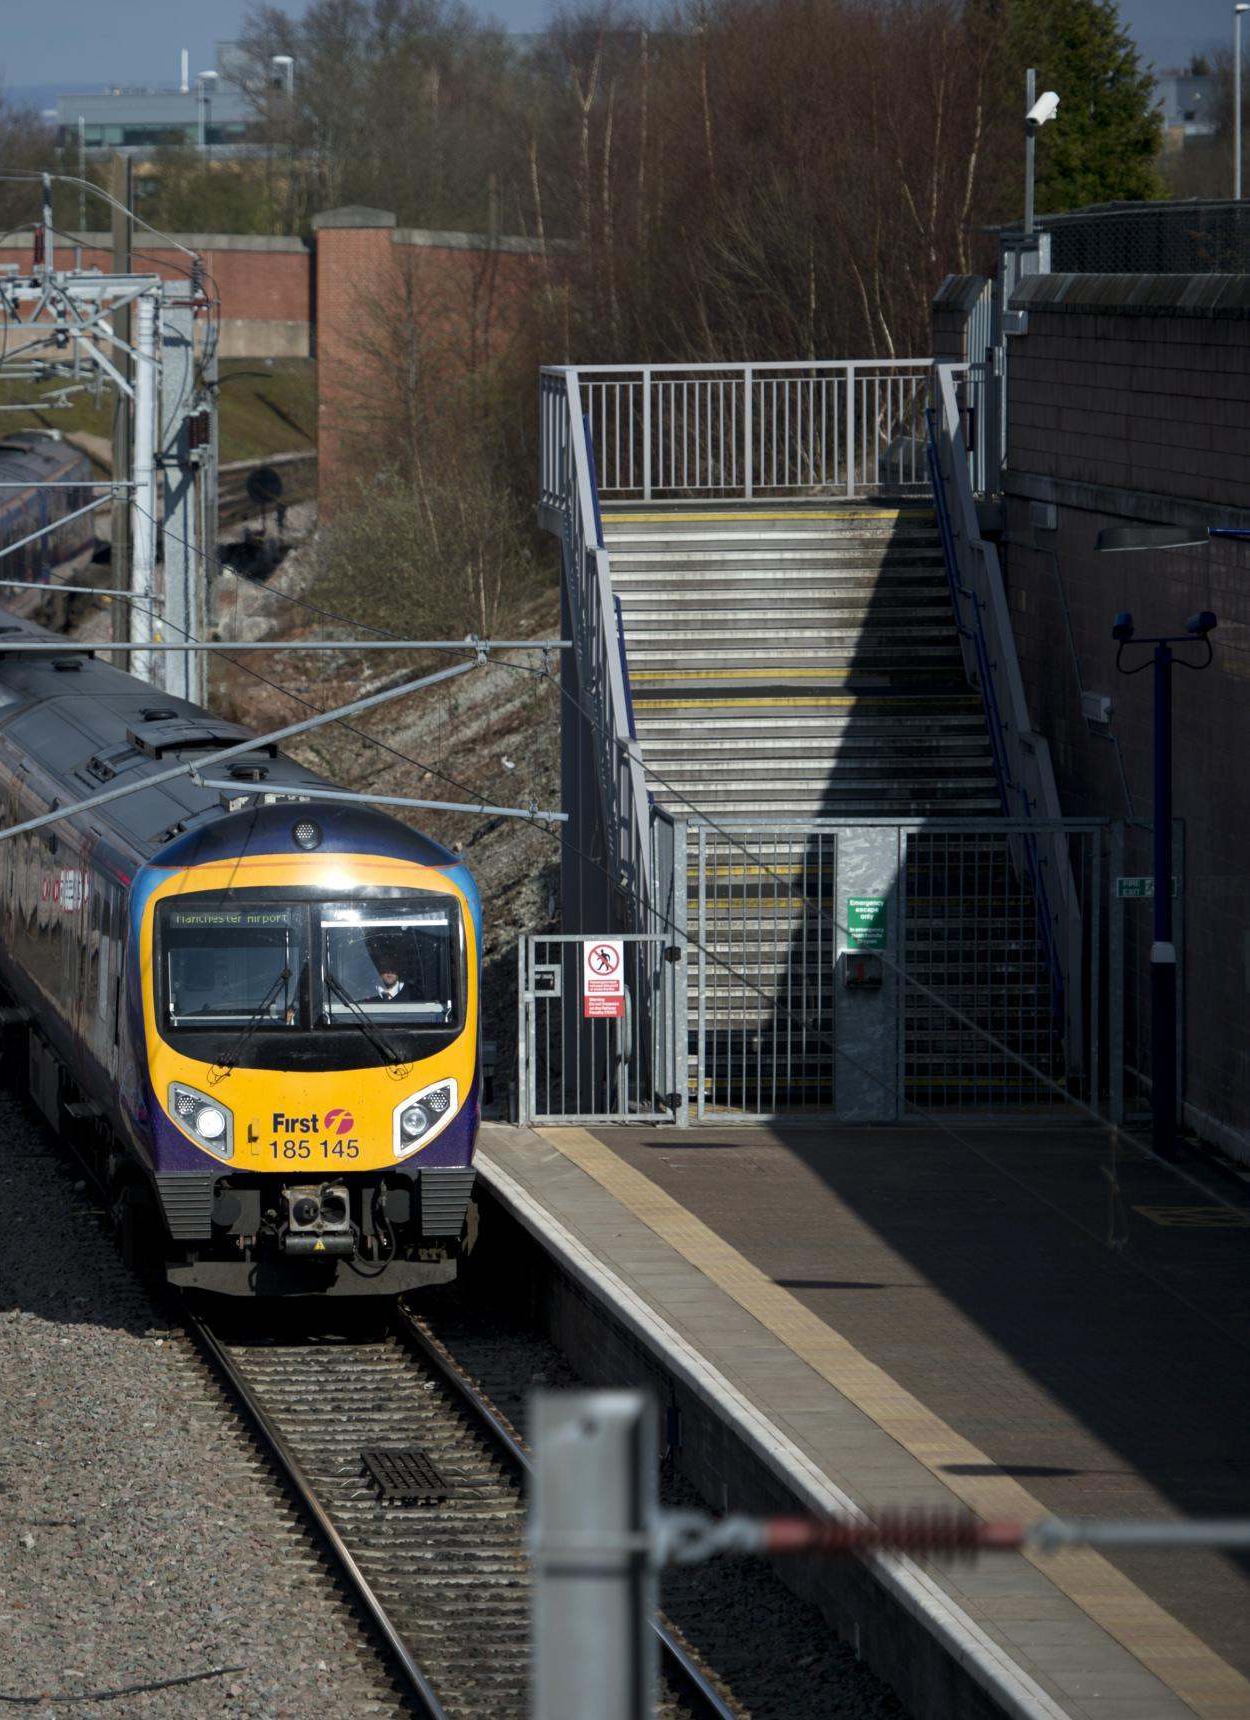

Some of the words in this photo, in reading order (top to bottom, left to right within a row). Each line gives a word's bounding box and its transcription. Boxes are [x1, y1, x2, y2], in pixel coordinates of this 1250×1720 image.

[272, 1113, 319, 1133] First
[269, 1139, 311, 1159] 185
[319, 1139, 360, 1159] 145
